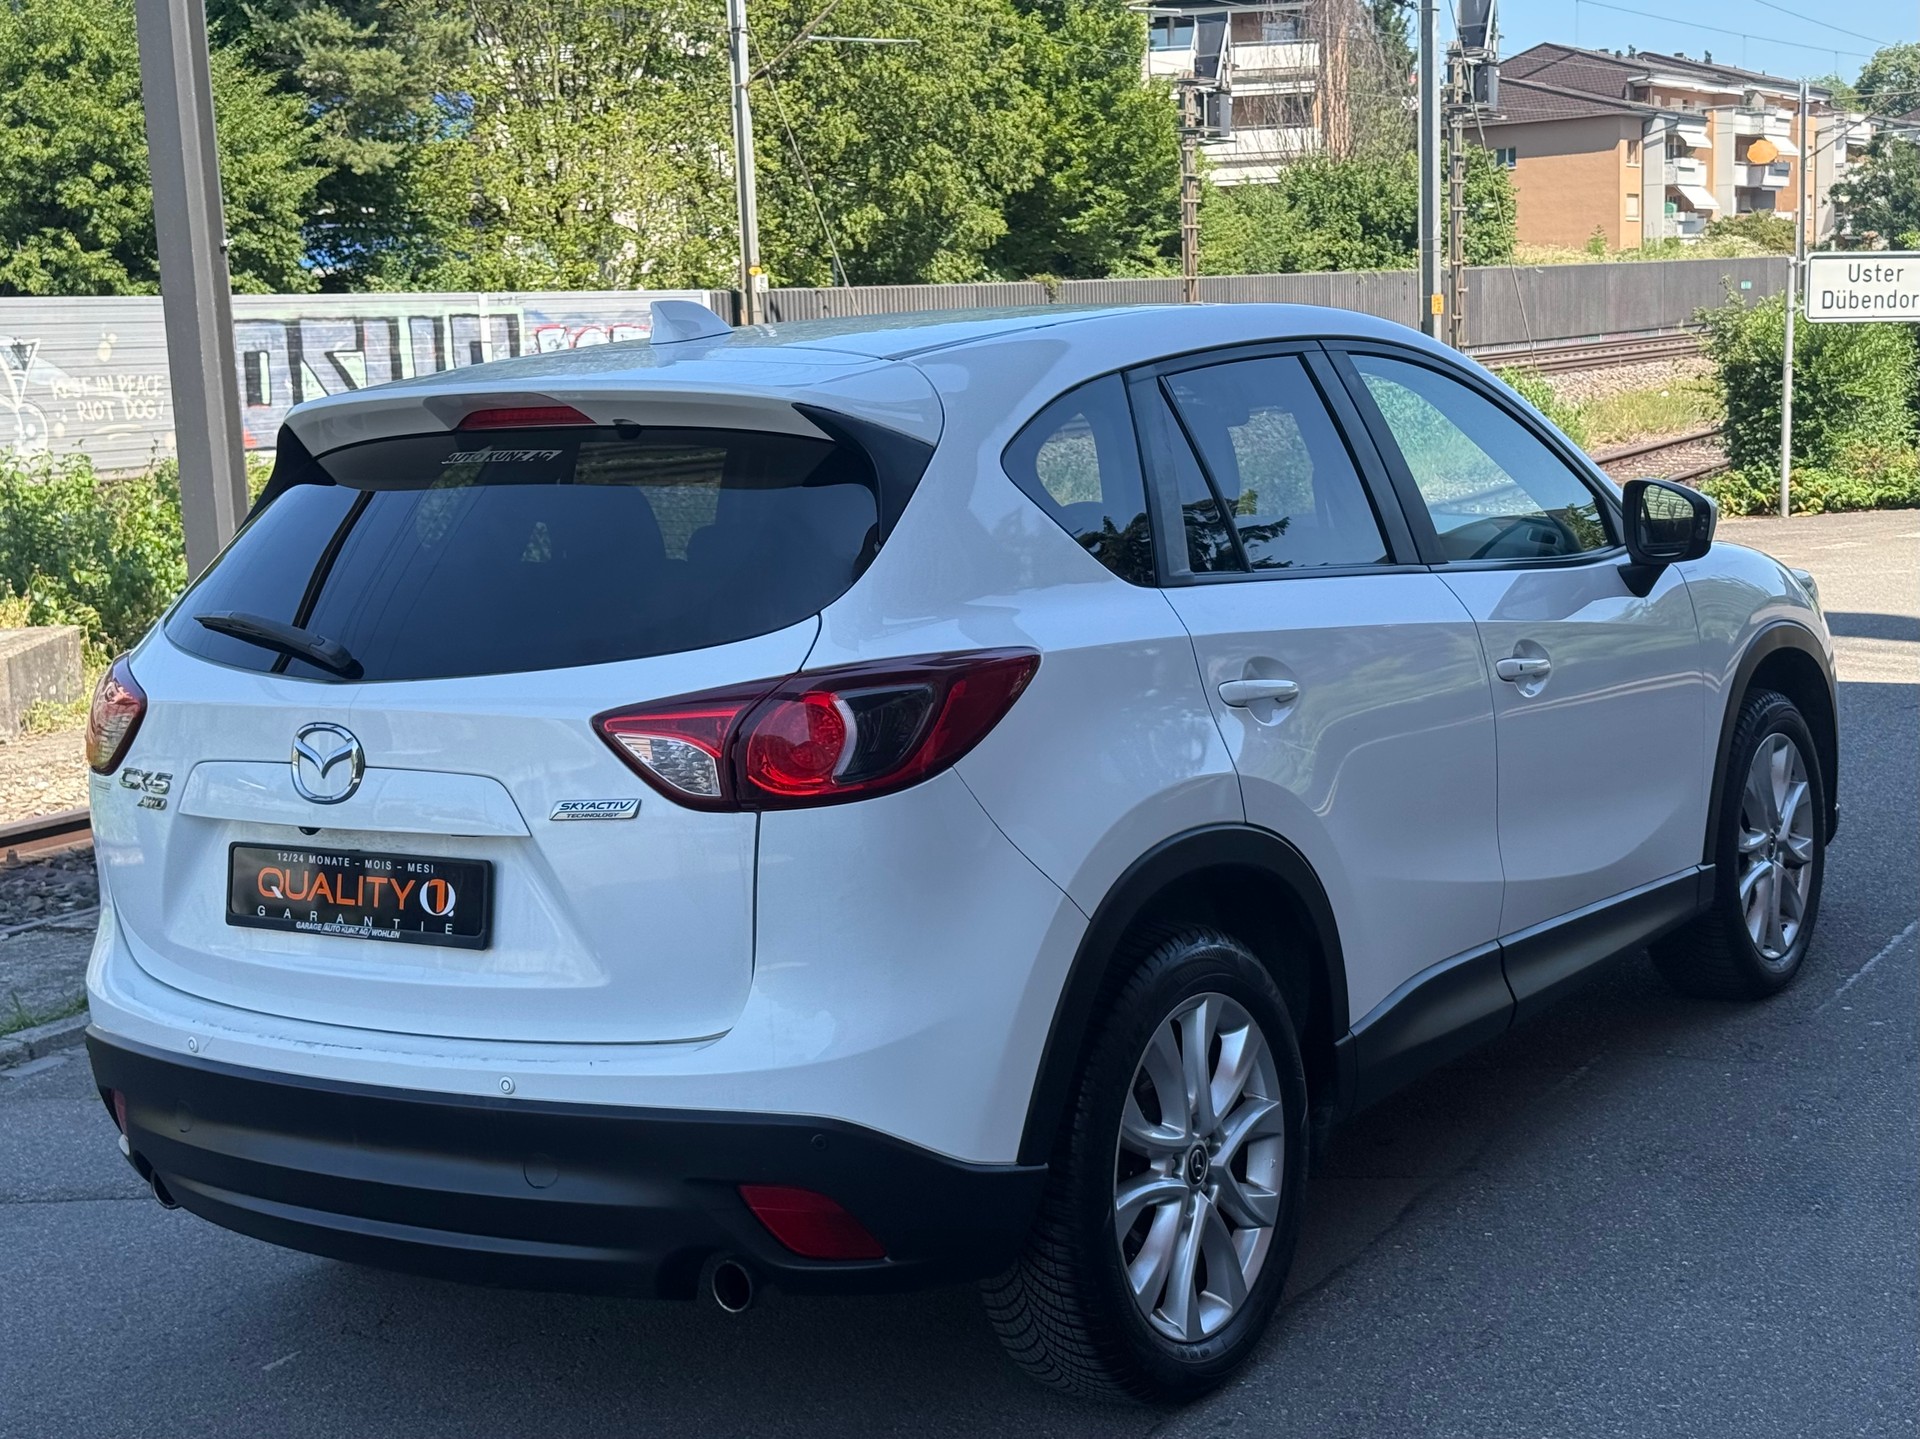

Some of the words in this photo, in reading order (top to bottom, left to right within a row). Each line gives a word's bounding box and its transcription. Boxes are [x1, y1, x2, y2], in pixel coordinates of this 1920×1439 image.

[1849, 264, 1904, 282] Uster
[1822, 290, 1920, 309] Dübendor
[96, 375, 114, 395] IN
[117, 374, 165, 397] PEACE
[77, 399, 116, 421] RIOT
[122, 398, 165, 420] DOG!
[486, 450, 533, 461] KUNZ
[119, 767, 173, 795] CX-5
[137, 795, 167, 810] AWD
[559, 802, 631, 810] SKYACTIV
[277, 852, 304, 863] 12/24
[308, 854, 350, 867] MONATE
[365, 860, 392, 870] MOIS
[407, 863, 434, 874] MESI
[257, 867, 416, 910] QUALITY
[257, 905, 454, 935] GARANTIE
[296, 921, 322, 931] GARAGE
[341, 927, 359, 935] KUNZ
[371, 929, 400, 939] WOHLEN
